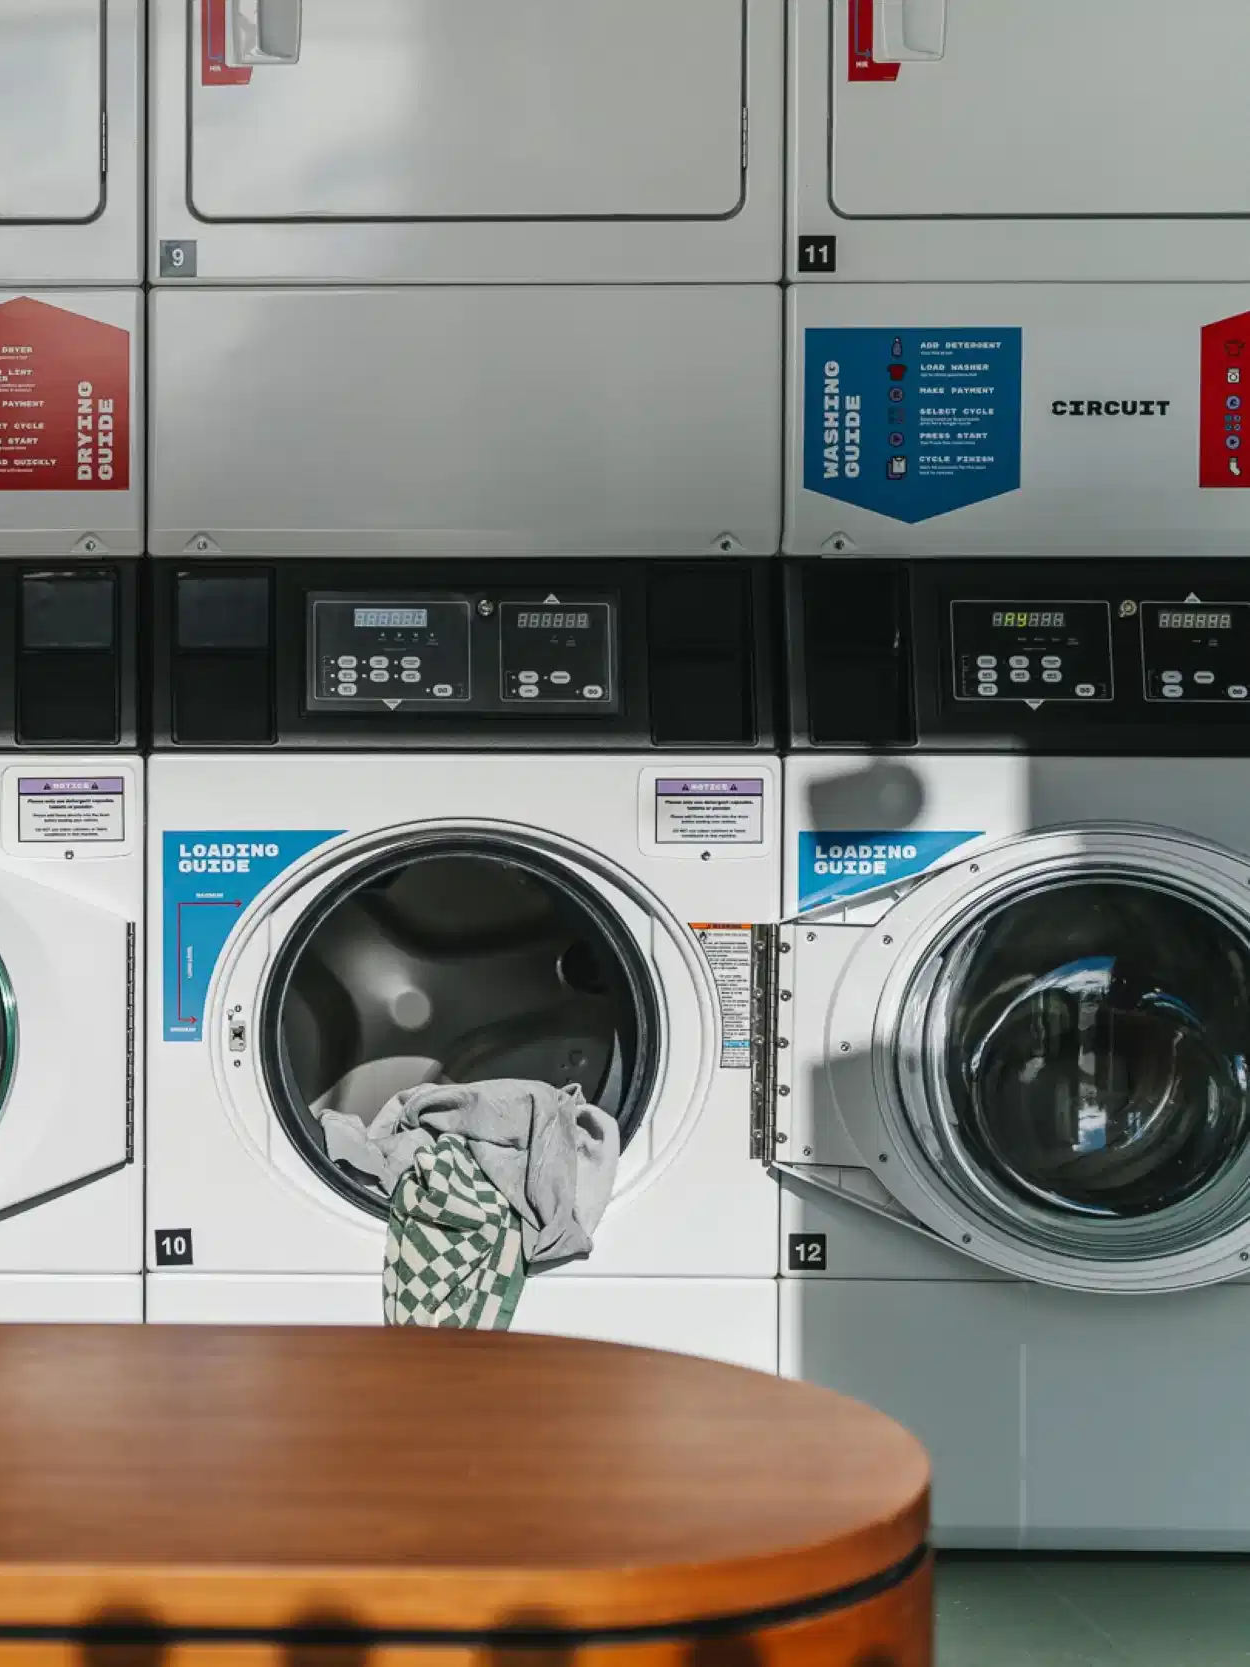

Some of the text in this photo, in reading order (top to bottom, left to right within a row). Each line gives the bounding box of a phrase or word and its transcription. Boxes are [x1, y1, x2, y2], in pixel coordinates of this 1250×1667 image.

[171, 247, 184, 267] 9
[804, 244, 829, 263] 11
[1051, 401, 1170, 415] CIRCUIT
[824, 361, 839, 478] WASHING
[77, 381, 92, 480] DRYING
[98, 399, 113, 480] GUIDE
[845, 396, 861, 477] GUIDE
[179, 844, 279, 857] LOADING
[815, 845, 917, 858] LOADING
[179, 860, 250, 873] GUIDE
[814, 861, 887, 874] GUIDE
[161, 1235, 186, 1255] 10
[795, 1243, 821, 1262] 12
